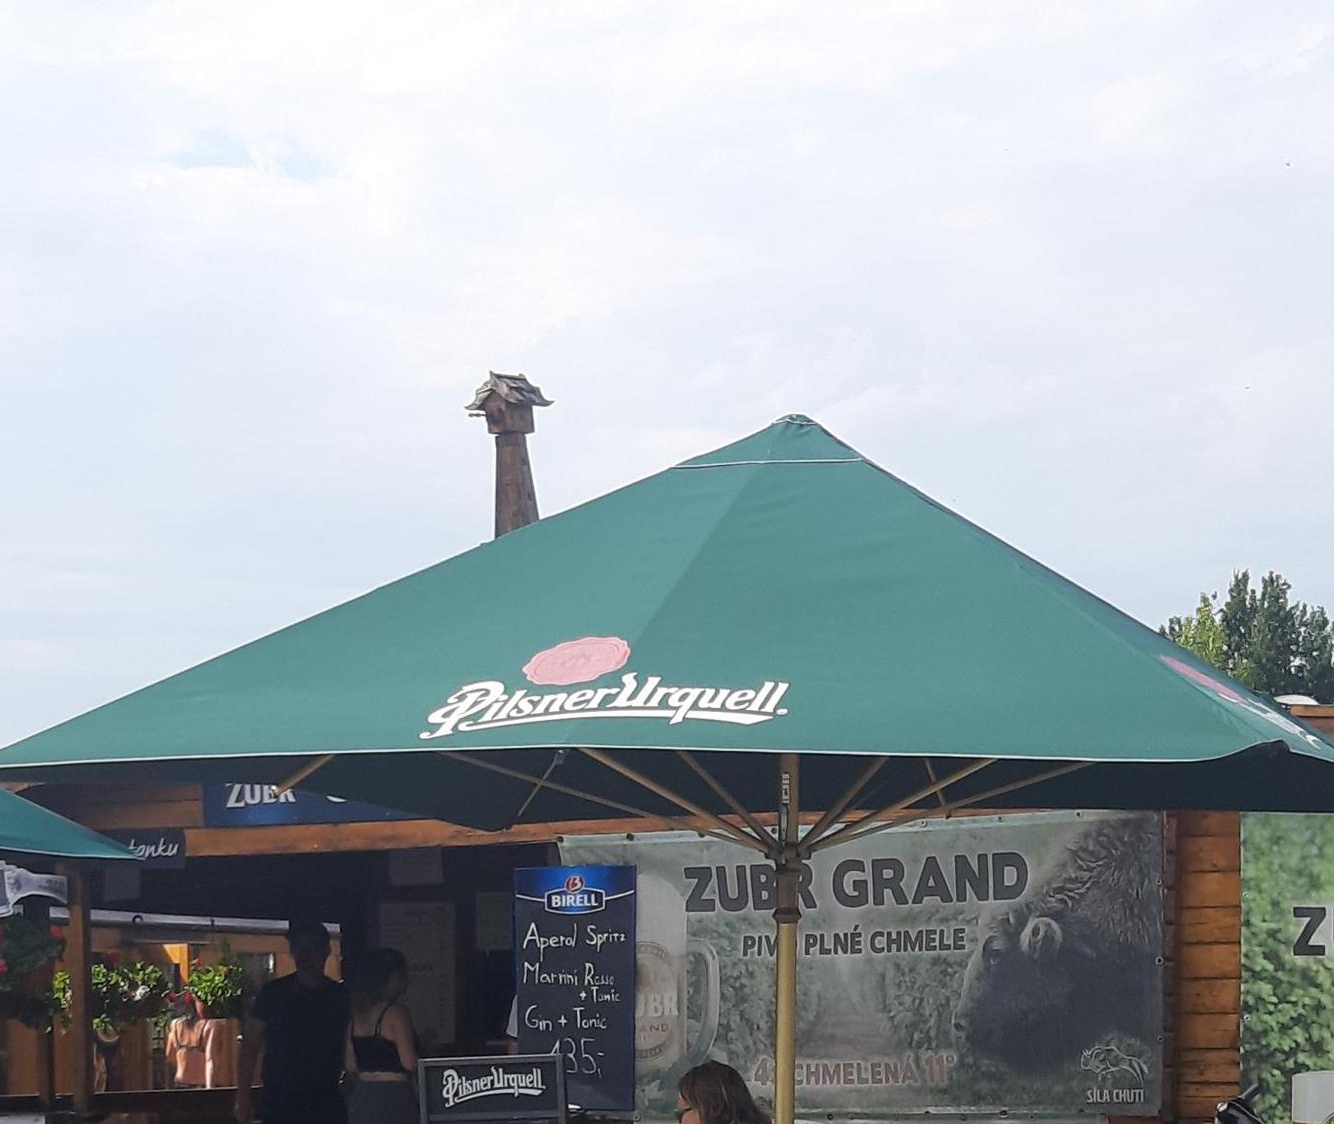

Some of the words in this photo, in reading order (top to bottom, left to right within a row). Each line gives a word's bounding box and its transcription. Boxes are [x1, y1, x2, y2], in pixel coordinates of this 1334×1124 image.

[418, 681, 627, 740] Pilsner
[832, 851, 1029, 909] GRAND
[551, 894, 599, 908] BIRELL
[522, 922, 578, 962] Aperol
[742, 934, 780, 957] PIV
[803, 923, 863, 956] PLNÉ
[870, 926, 967, 953] CHMELE
[525, 1005, 553, 1032] Gin
[572, 1006, 608, 1030] Tonic
[442, 1068, 494, 1108] Pilsner
